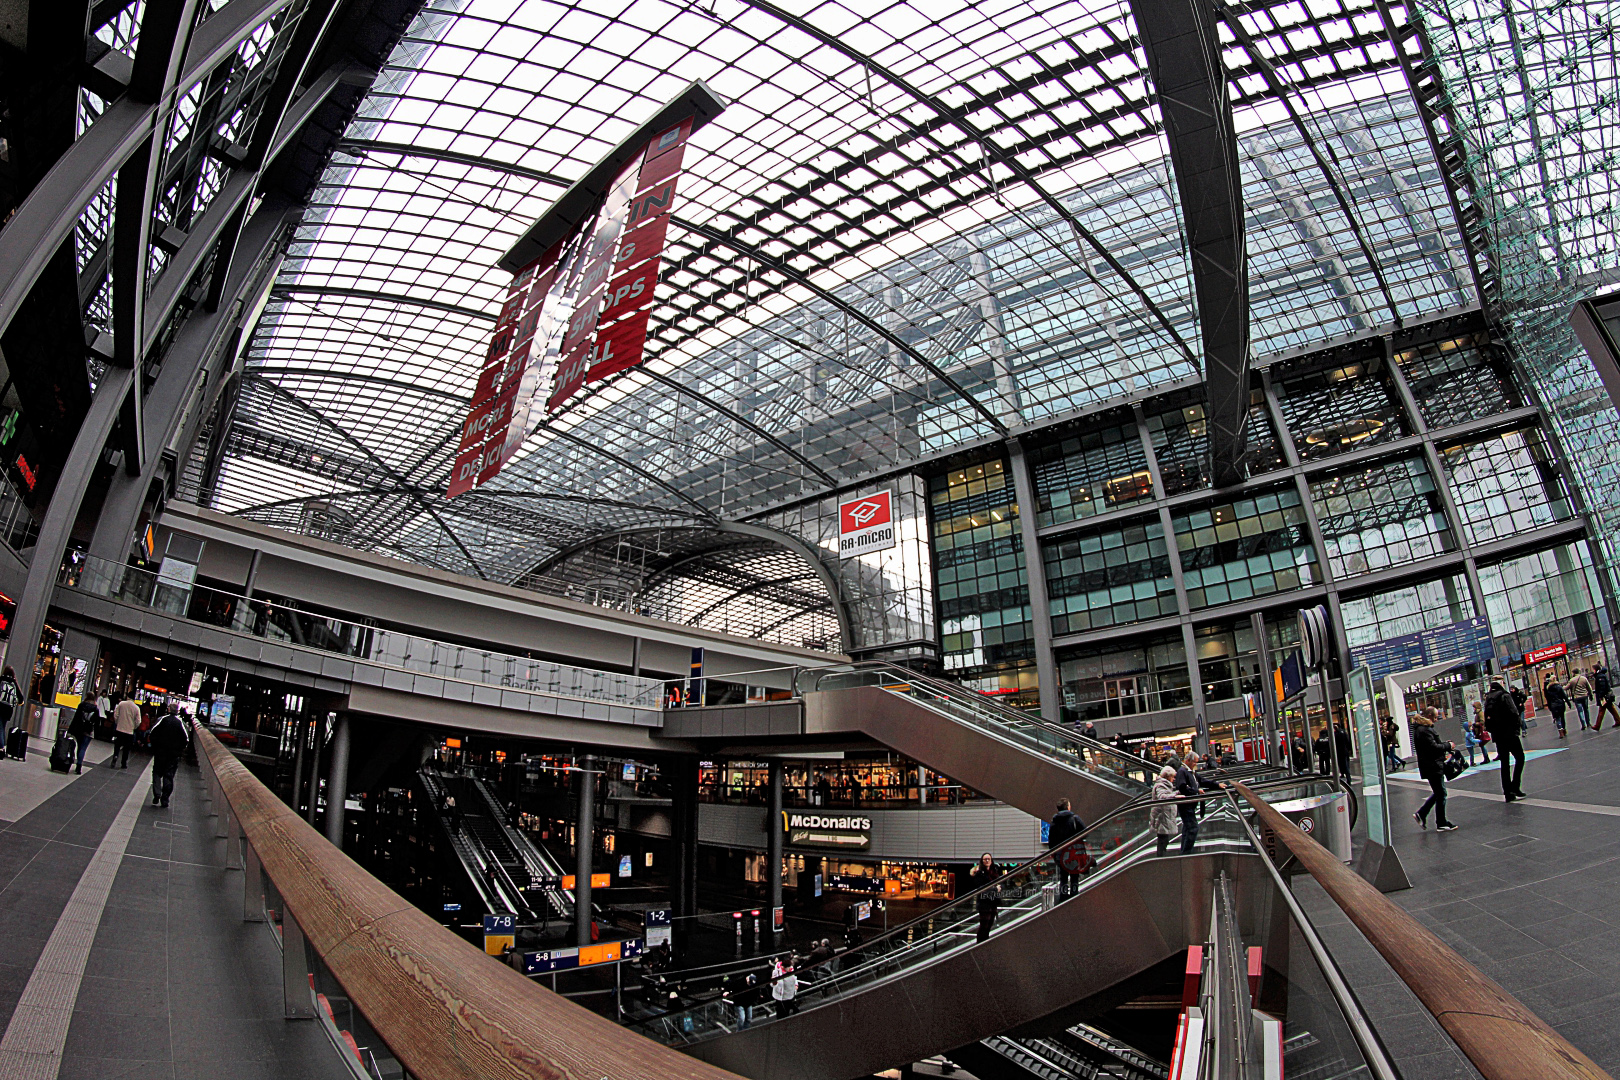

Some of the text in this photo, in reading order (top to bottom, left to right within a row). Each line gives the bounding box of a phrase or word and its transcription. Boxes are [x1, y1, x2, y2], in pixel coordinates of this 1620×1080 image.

[464, 402, 507, 439] MORE
[790, 814, 871, 830] McDonald's
[650, 911, 665, 921] 1-2
[492, 916, 512, 927] 7-8
[625, 940, 636, 949] 1-4
[535, 953, 549, 962] 5-8
